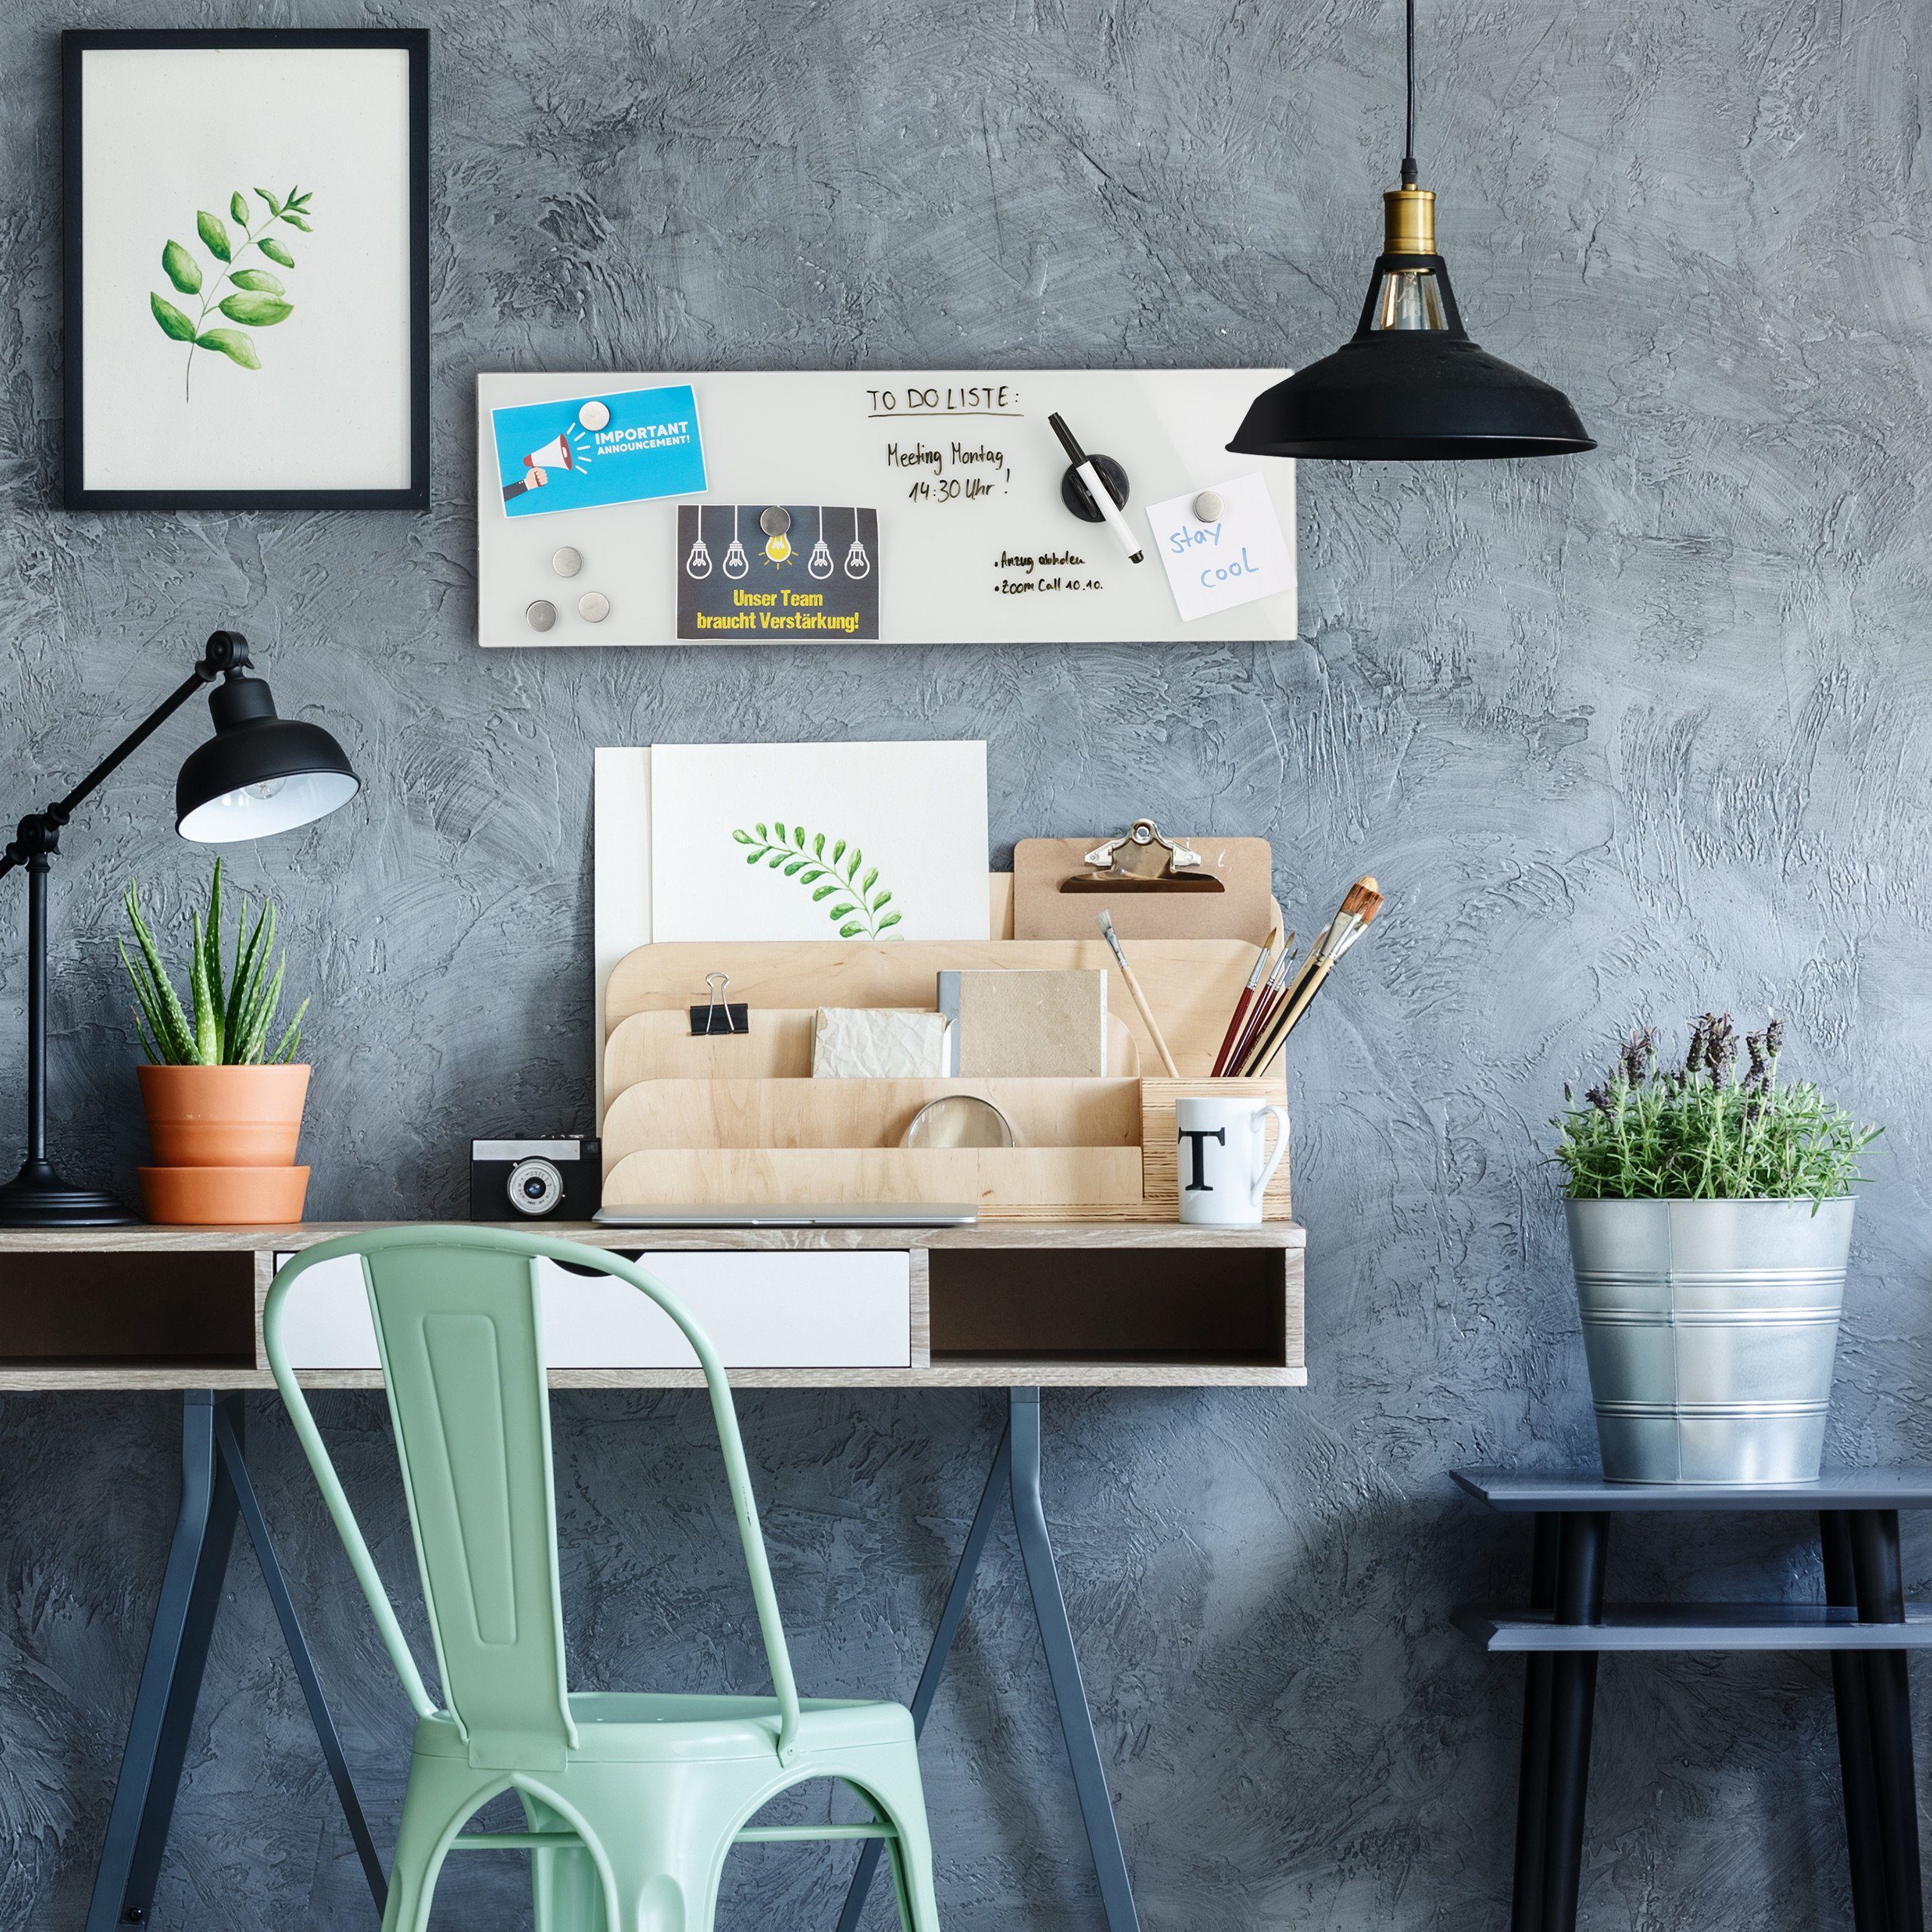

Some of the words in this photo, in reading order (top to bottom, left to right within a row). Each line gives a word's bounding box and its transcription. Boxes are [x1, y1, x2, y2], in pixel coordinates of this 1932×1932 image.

[866, 389, 897, 411] TO
[907, 388, 940, 408] DO
[946, 386, 1020, 410] LISTE:
[595, 421, 688, 445] IMPORTANT
[597, 435, 691, 456] ANNOUNCEMENT!
[887, 442, 943, 476] Meeting
[951, 441, 1004, 471] Montag
[908, 479, 961, 503] 14:30
[1169, 522, 1223, 554] stay
[1001, 550, 1035, 574] Anzug
[1200, 546, 1260, 588] cool
[1038, 577, 1061, 592] Call
[1065, 580, 1103, 591] 10.10.
[733, 589, 777, 607] Unser
[780, 589, 823, 607] Team
[697, 611, 756, 629] braucht
[759, 611, 860, 633] Verstärkung!
[1177, 1126, 1226, 1191] T
